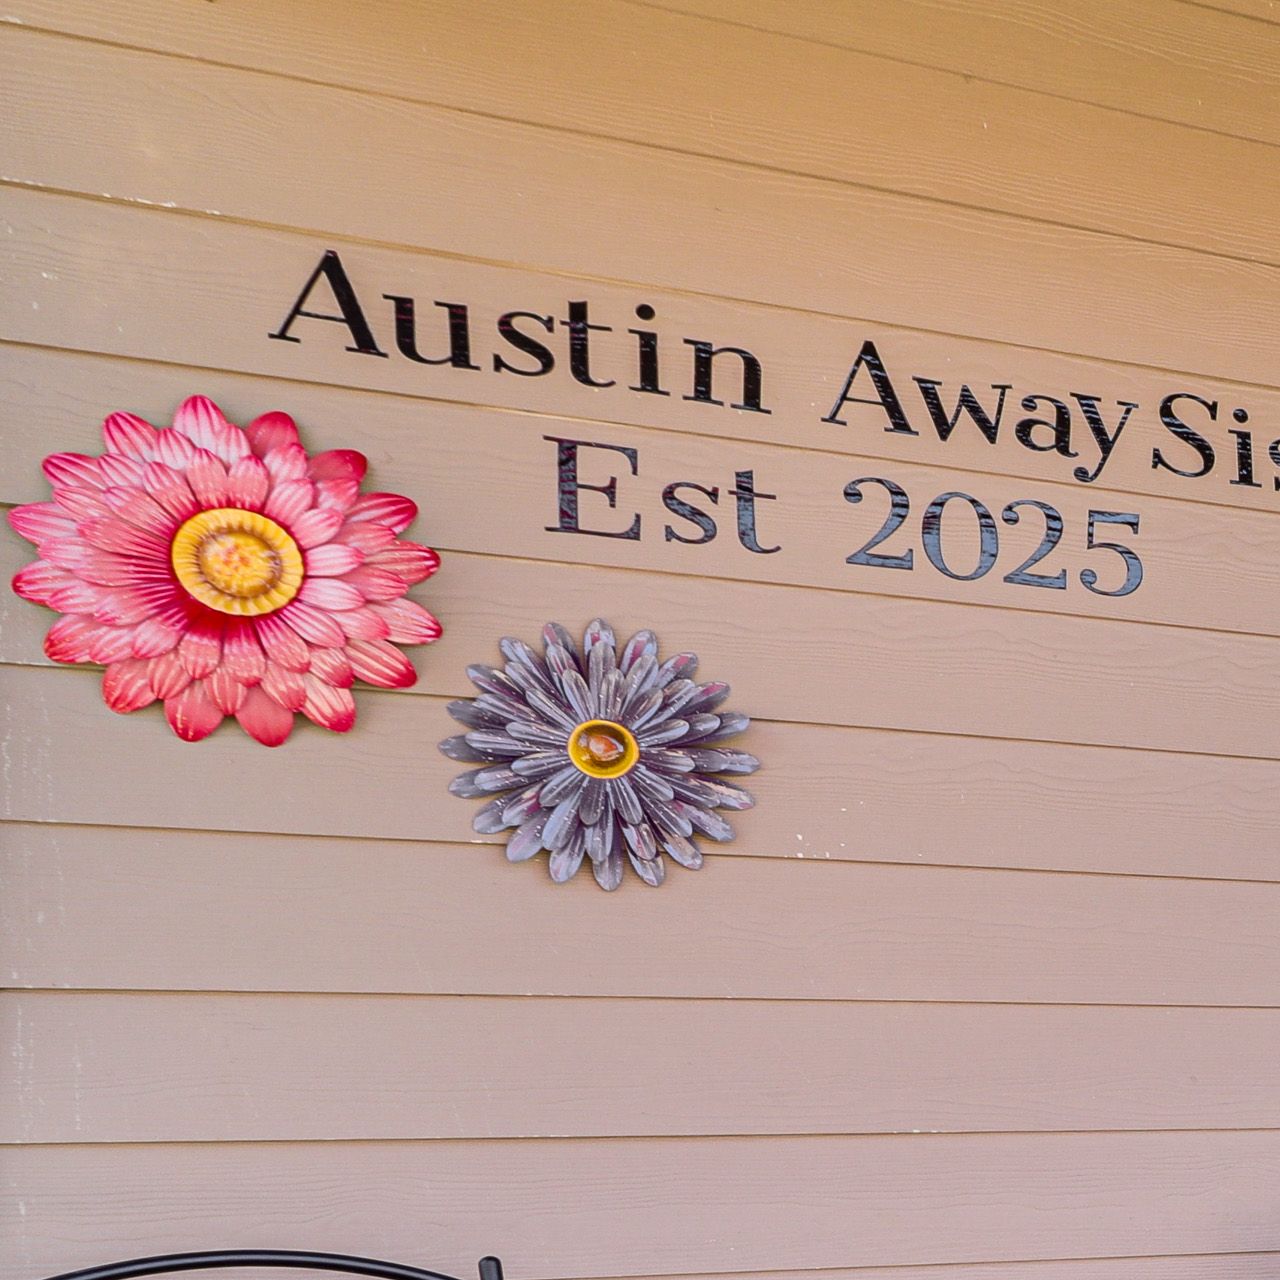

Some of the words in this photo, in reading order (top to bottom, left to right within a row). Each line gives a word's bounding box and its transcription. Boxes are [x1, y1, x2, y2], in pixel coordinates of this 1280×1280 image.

[268, 249, 772, 416] Austin
[543, 434, 782, 555] Est
[844, 476, 1144, 597] 2025
